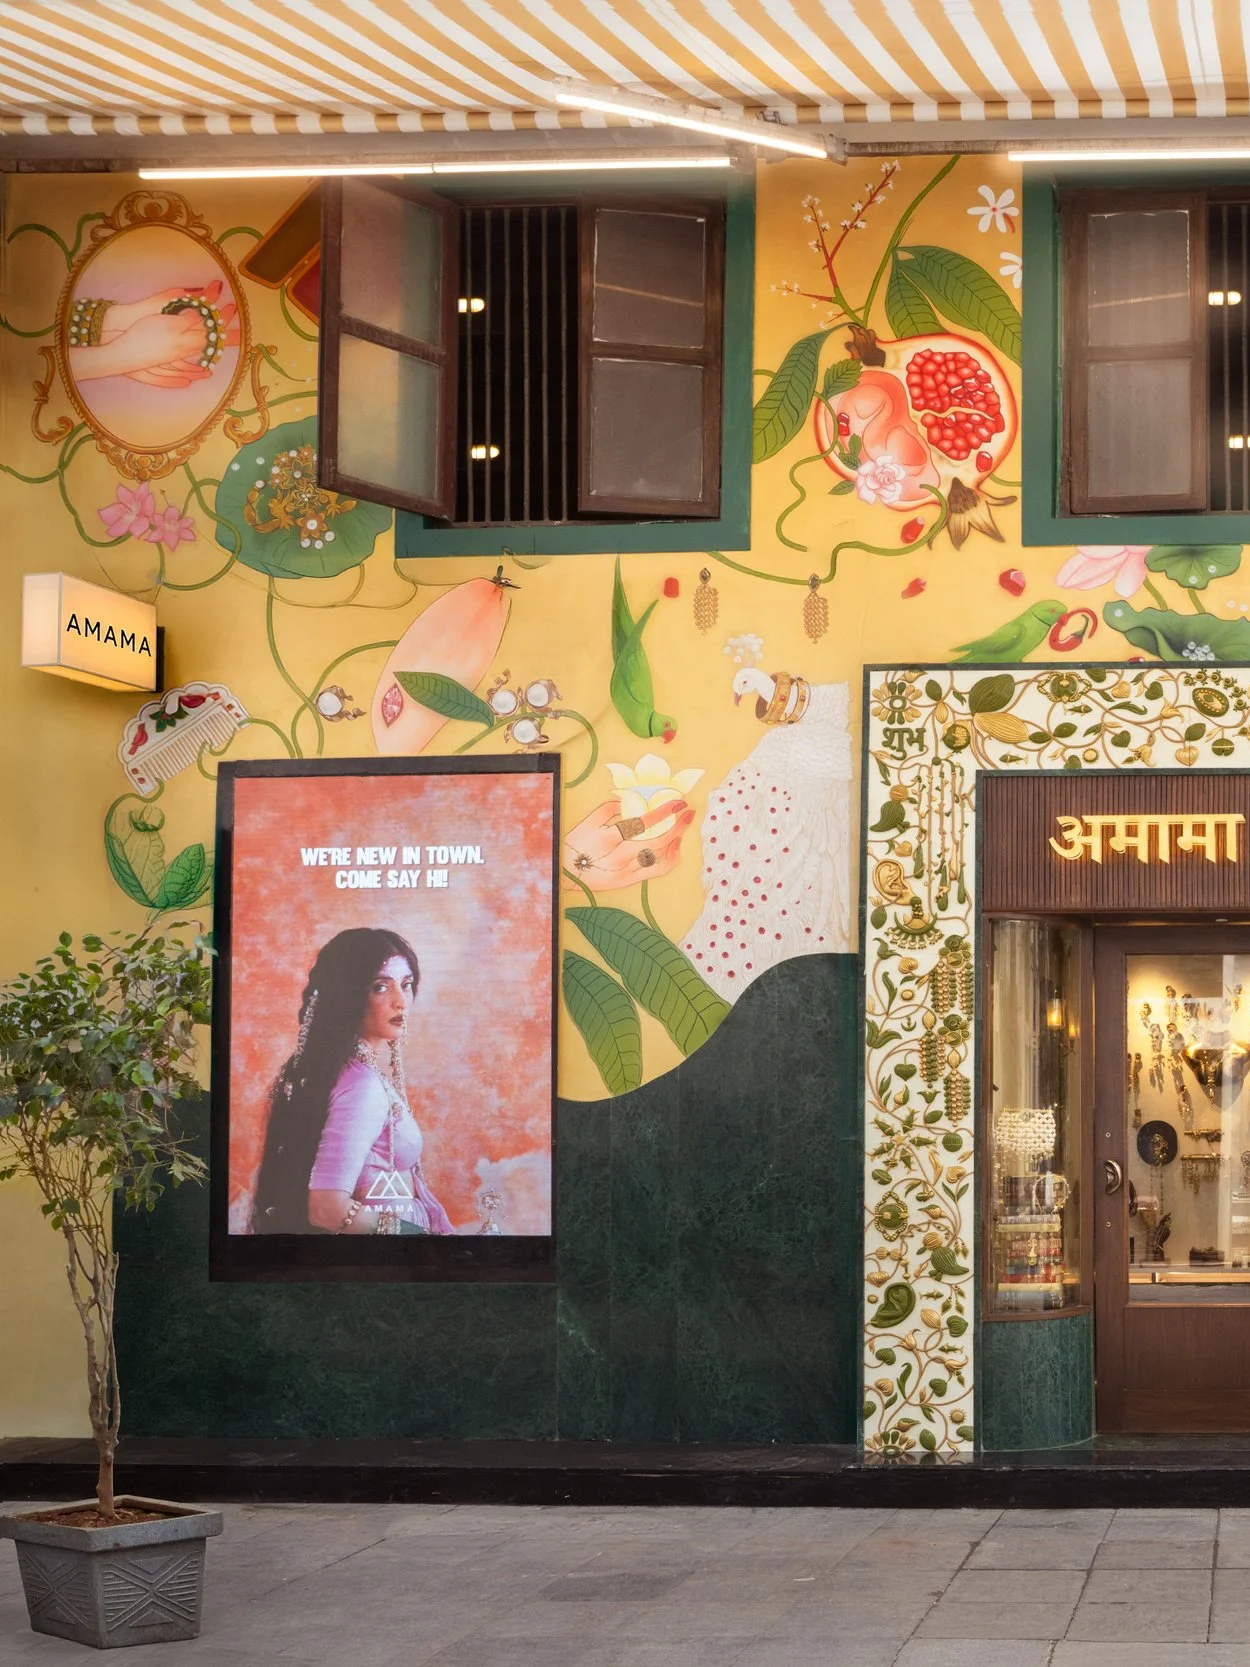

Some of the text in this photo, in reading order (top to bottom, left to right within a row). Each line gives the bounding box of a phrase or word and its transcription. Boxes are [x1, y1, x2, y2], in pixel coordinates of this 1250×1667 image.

[66, 613, 152, 657] AMAMA
[882, 727, 926, 760] शुभ
[1048, 813, 1246, 864] अमामा
[300, 846, 486, 867] WE'RE NEW IN TOWN.
[335, 869, 449, 889] COME SAY HI!
[364, 1204, 414, 1212] AMAMA
